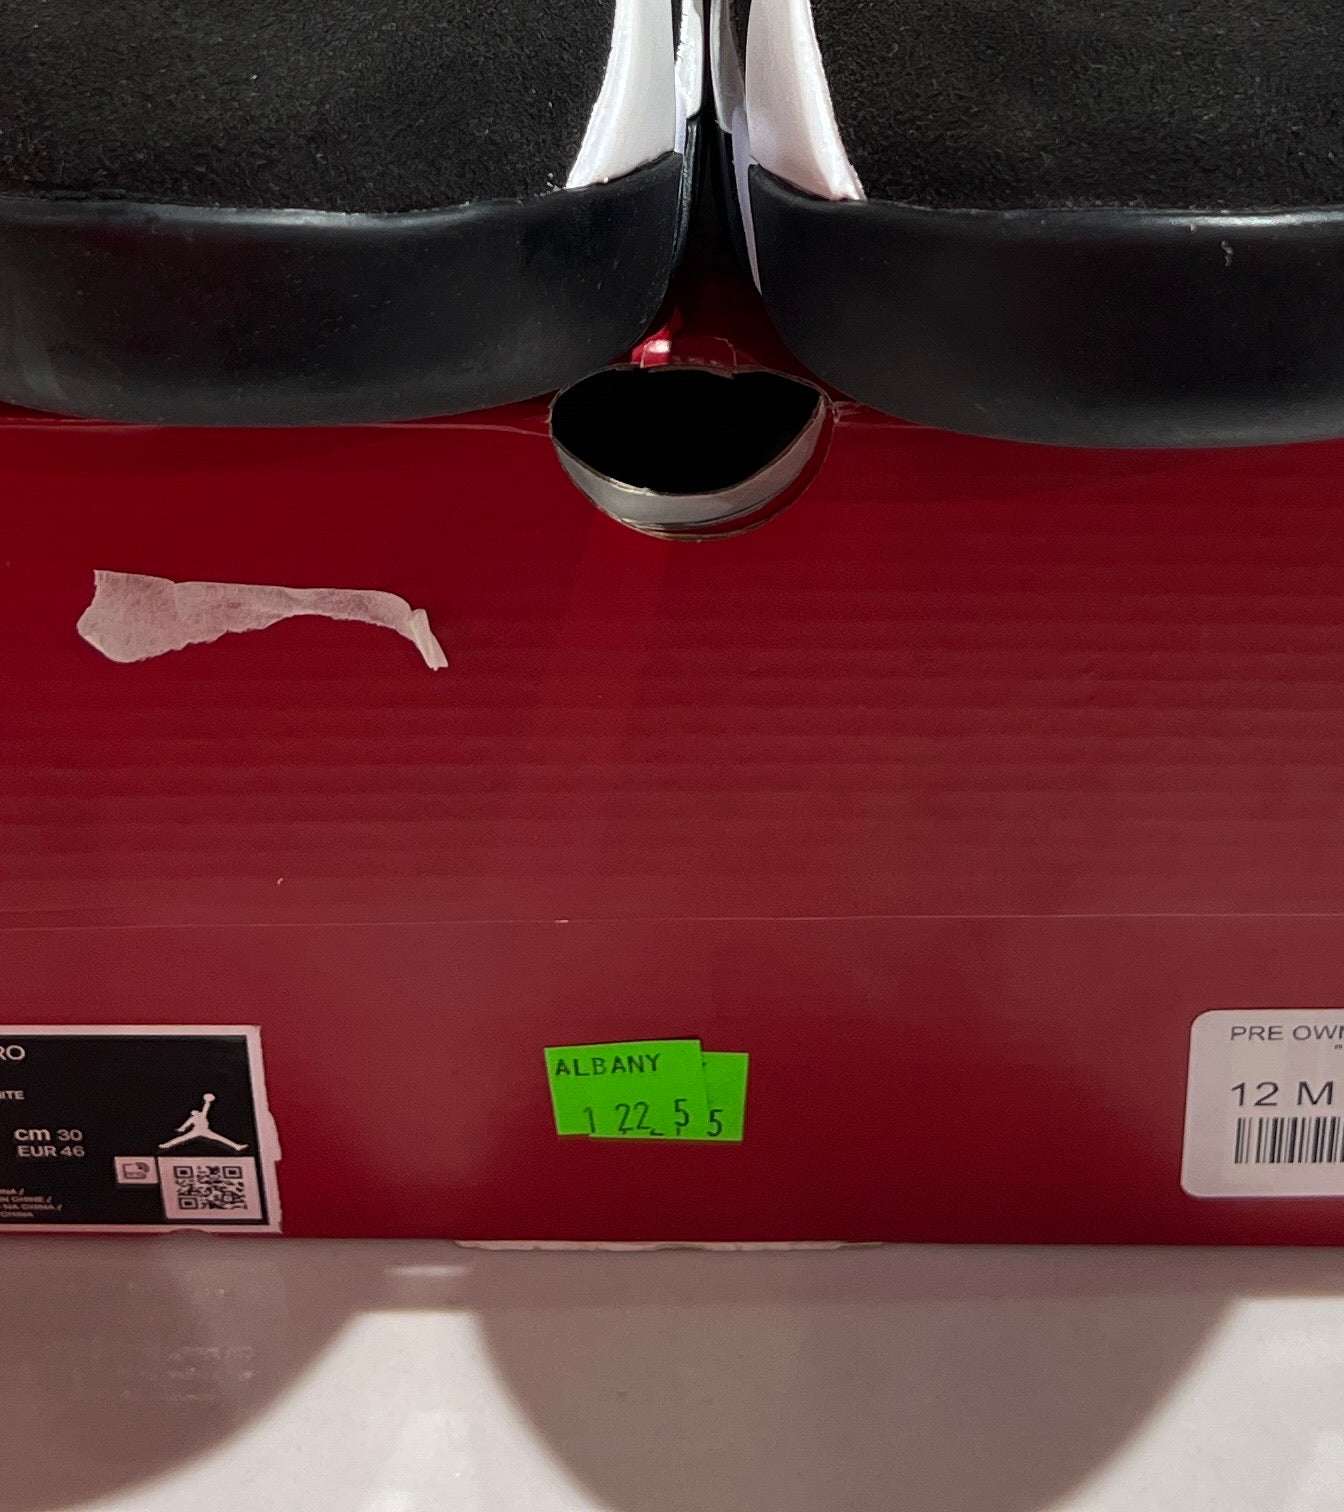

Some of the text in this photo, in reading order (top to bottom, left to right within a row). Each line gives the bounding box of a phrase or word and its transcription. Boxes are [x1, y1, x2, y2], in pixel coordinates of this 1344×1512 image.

[1231, 1025, 1283, 1041] PRE
[555, 1053, 660, 1077] ALBANY
[1231, 1080, 1334, 1107] 12 M
[14, 1128, 83, 1141] cm 30
[17, 1146, 84, 1157] EUR 46
